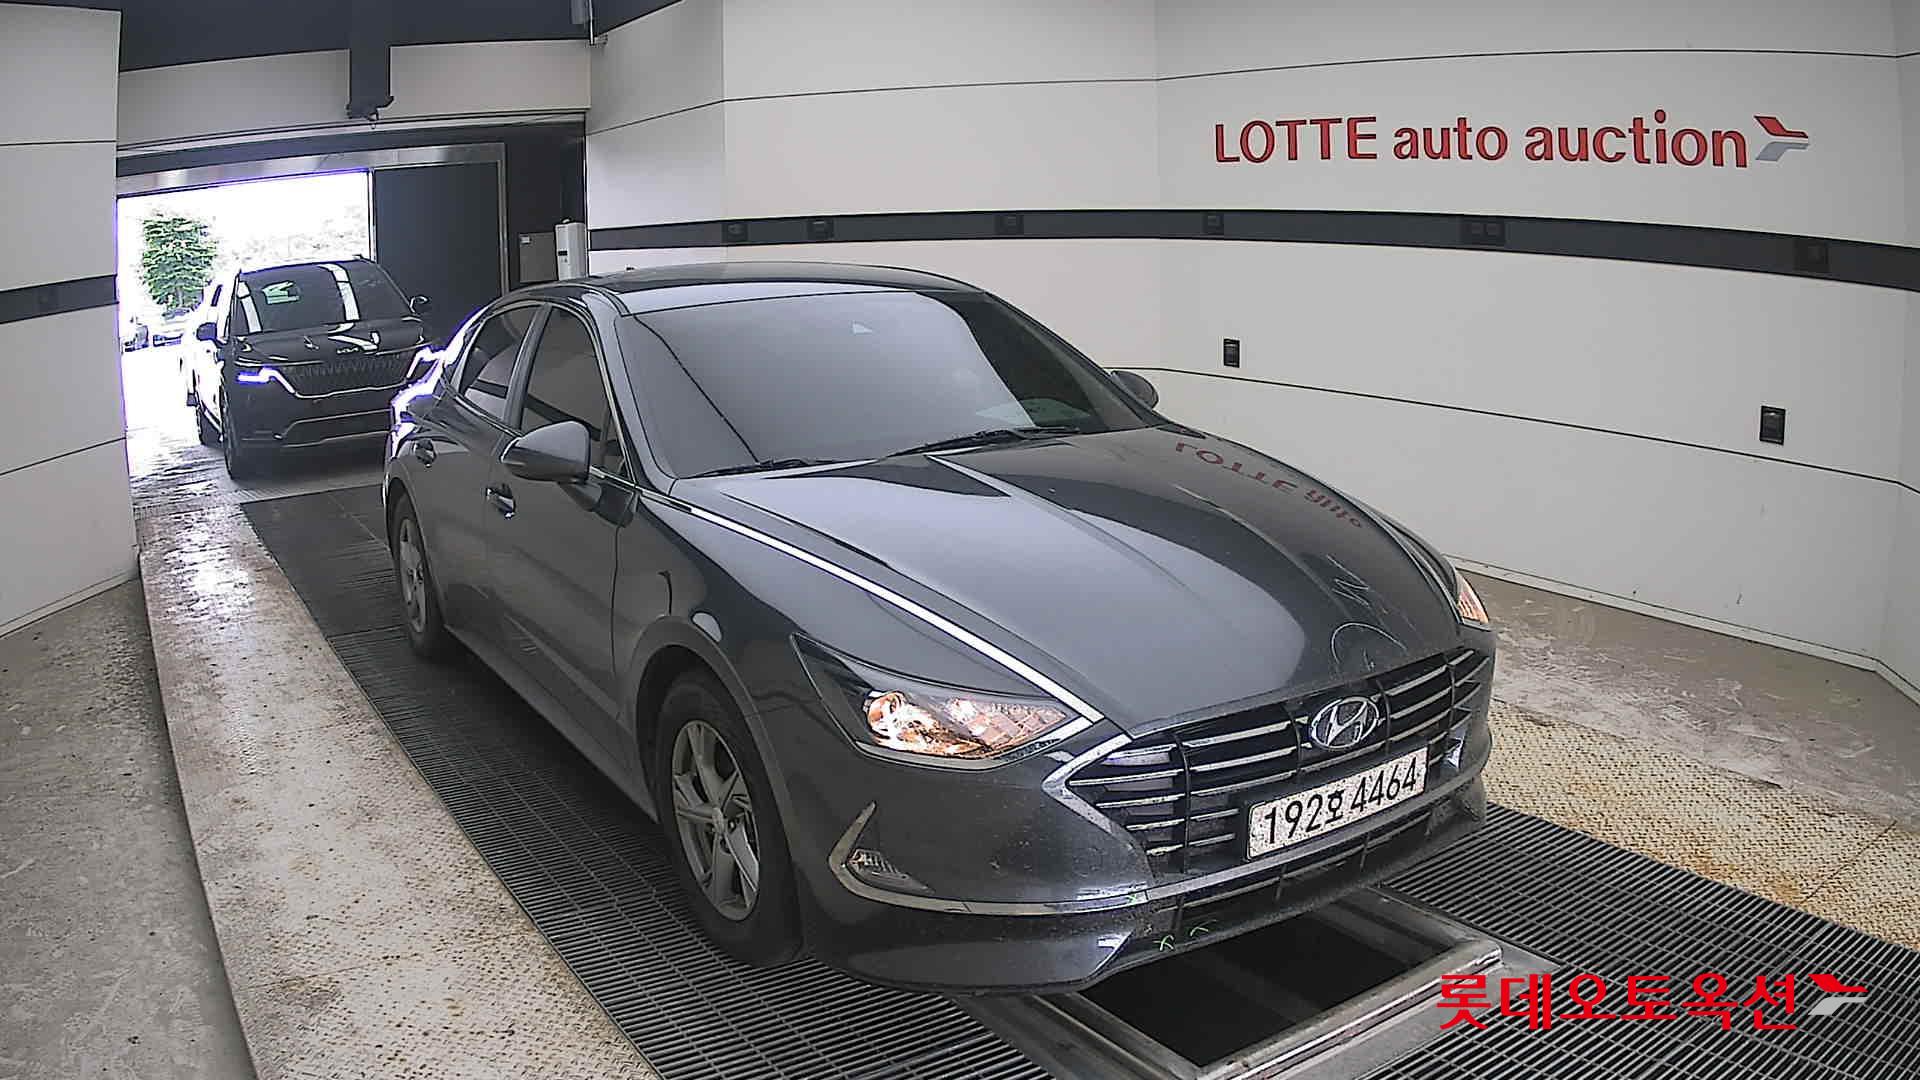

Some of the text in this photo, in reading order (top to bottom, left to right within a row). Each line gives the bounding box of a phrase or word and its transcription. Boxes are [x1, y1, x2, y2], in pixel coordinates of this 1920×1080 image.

[1214, 110, 1748, 168] LOTTE auto auction
[1350, 756, 1417, 813] 4464
